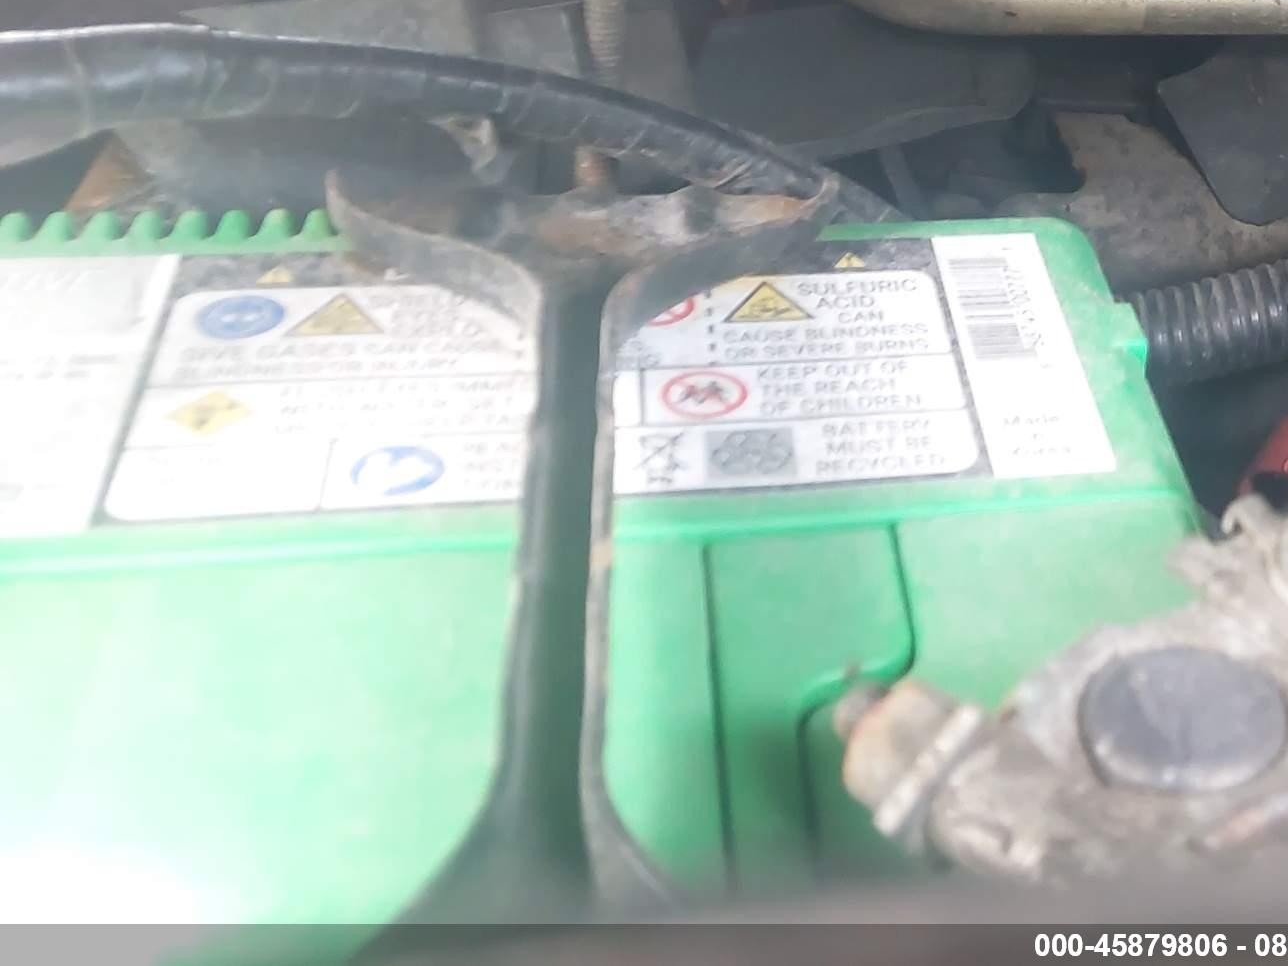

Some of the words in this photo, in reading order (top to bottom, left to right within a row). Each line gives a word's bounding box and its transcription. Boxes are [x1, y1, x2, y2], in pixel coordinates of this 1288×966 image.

[798, 278, 918, 297] SULFURIC
[816, 295, 875, 309] ACID
[838, 310, 885, 324] CAN
[722, 328, 799, 345] CAUSE
[805, 323, 930, 341] BLINDNESS
[723, 345, 756, 361] OR
[762, 341, 846, 358] SEVERE
[854, 337, 930, 354] BURNS
[757, 365, 817, 381] KEEP
[824, 362, 872, 378] OUT
[879, 360, 910, 375] OF
[759, 383, 806, 398] THE
[814, 378, 897, 395] REACH
[759, 400, 791, 415] OF
[800, 394, 922, 413] CHILDREN
[821, 417, 931, 436] BATTERY
[825, 437, 895, 456] MUST
[905, 435, 933, 450] BE
[815, 454, 946, 475] RECYCLED
